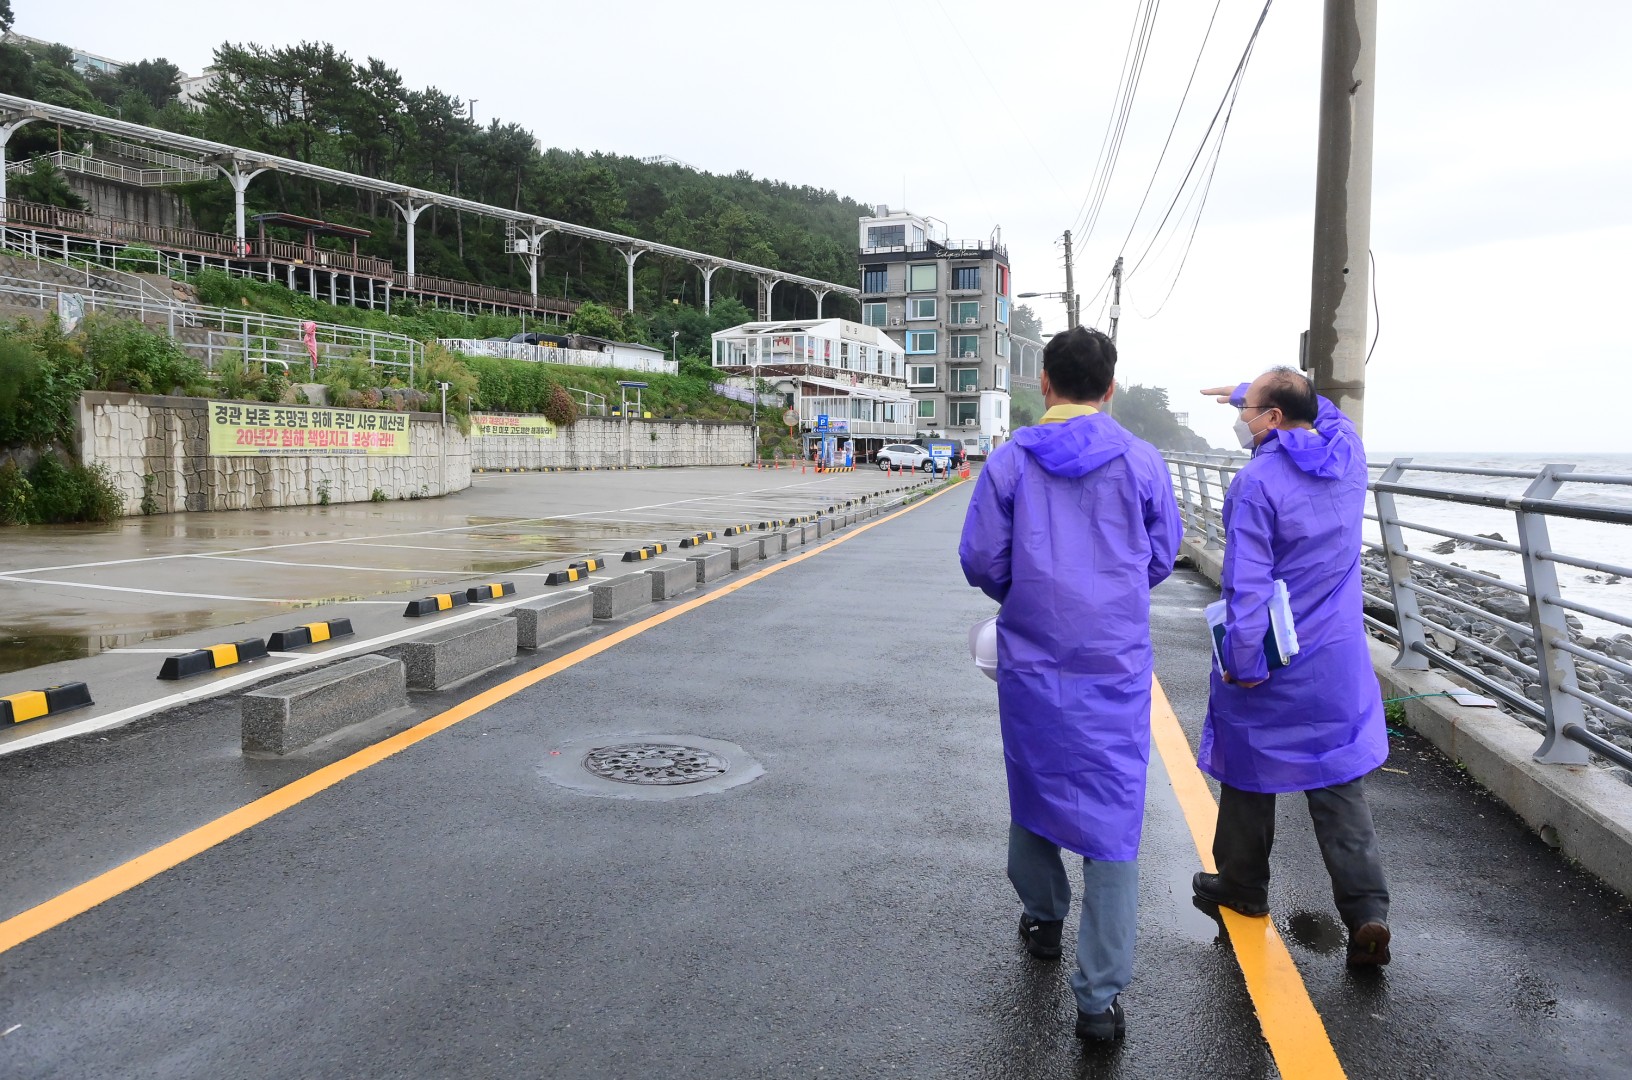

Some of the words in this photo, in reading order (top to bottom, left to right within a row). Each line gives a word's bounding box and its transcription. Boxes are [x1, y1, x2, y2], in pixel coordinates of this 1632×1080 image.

[935, 249, 954, 262] Edge
[215, 405, 242, 425] 경관
[245, 407, 270, 427] 보존
[273, 409, 308, 428] 조망권
[312, 411, 332, 428] 위해
[335, 412, 355, 430] 주민
[357, 414, 377, 430] 사유
[379, 415, 405, 431] 재산권
[236, 428, 278, 447] 20년간
[282, 429, 304, 447] 침해
[308, 430, 349, 447] 책임지고
[351, 431, 394, 448] 보상하라!!
